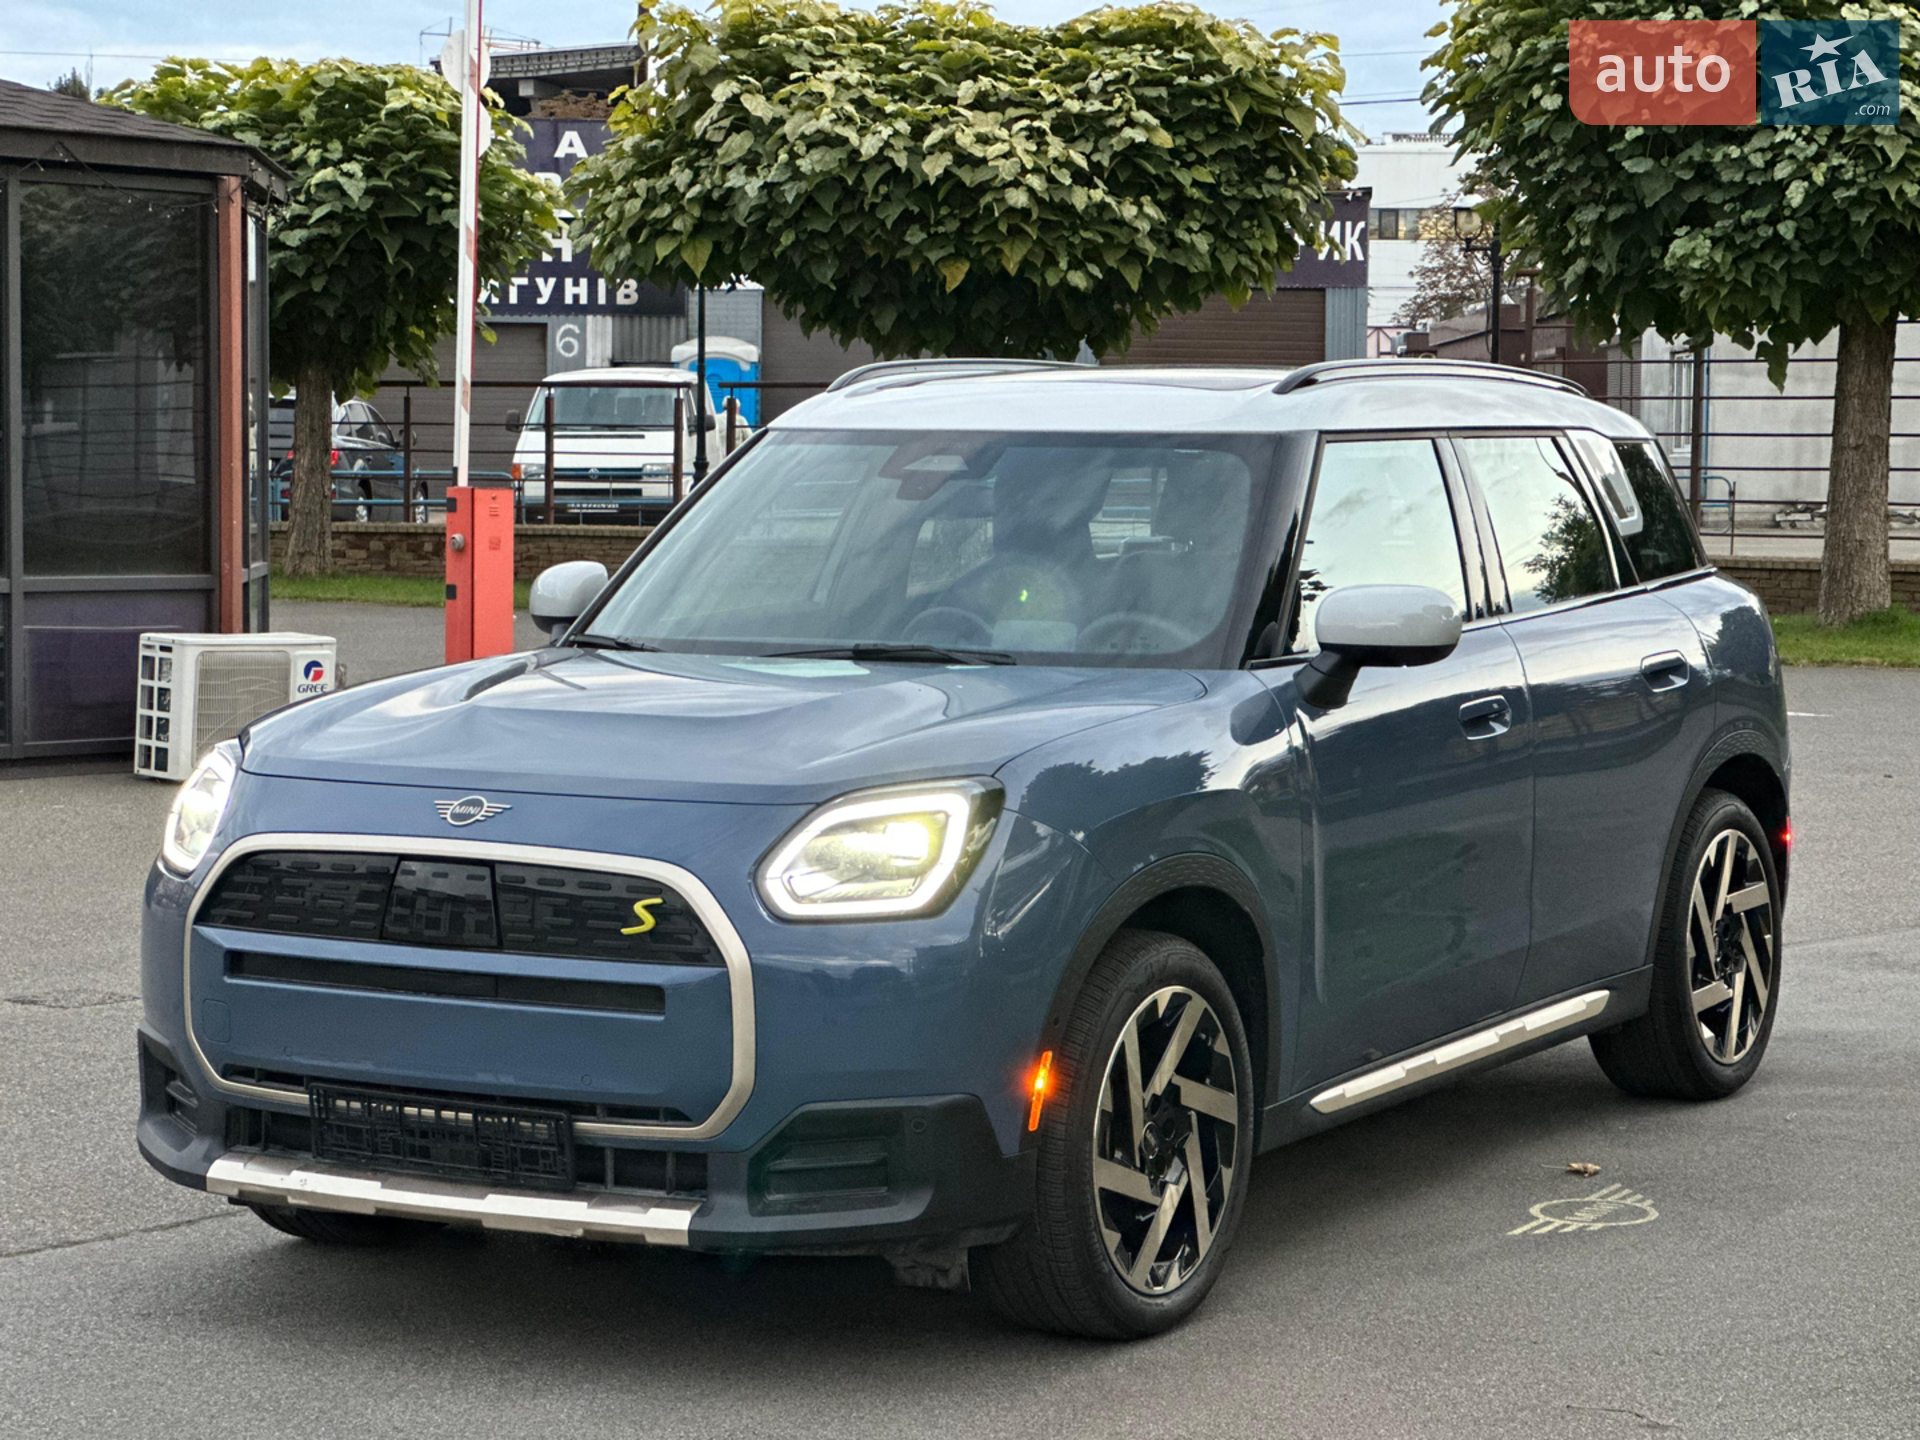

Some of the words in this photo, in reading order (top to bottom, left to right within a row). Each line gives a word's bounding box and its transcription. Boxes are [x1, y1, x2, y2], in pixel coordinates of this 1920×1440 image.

[556, 324, 580, 358] 6
[297, 683, 329, 694] GREE
[452, 805, 482, 815] MINI
[620, 897, 664, 935] S
